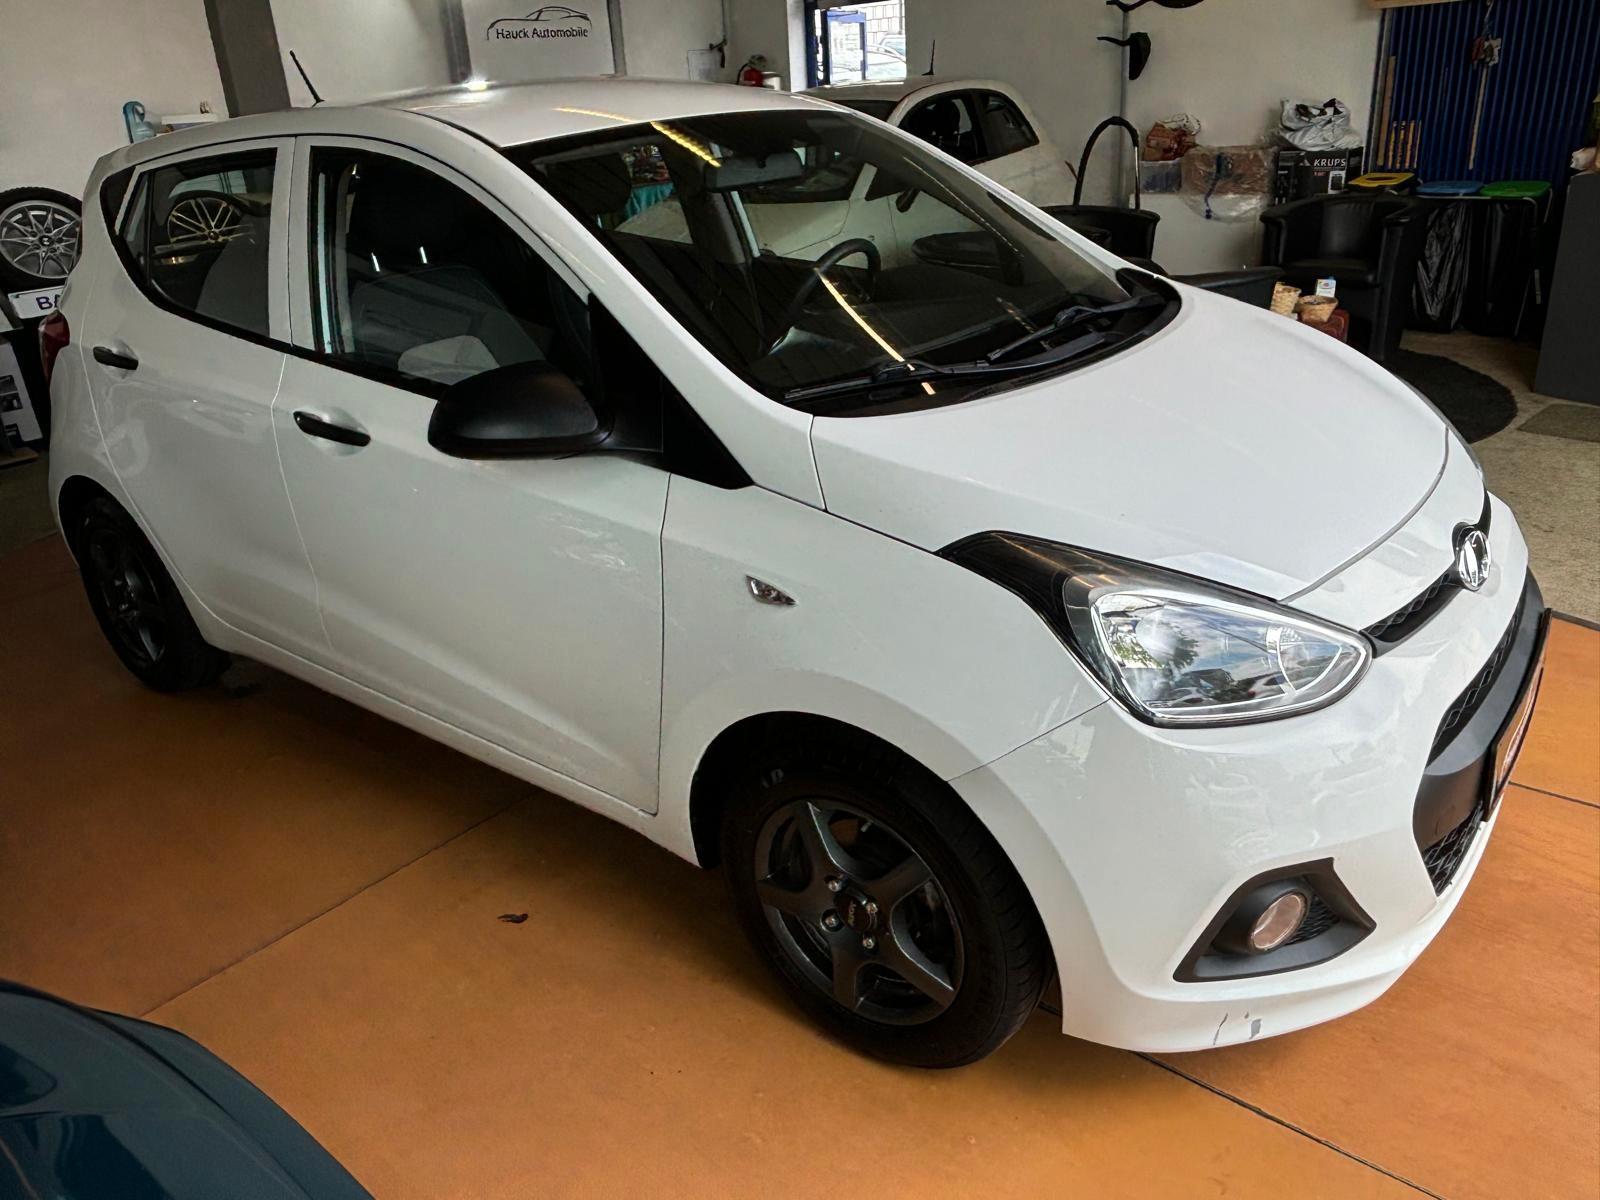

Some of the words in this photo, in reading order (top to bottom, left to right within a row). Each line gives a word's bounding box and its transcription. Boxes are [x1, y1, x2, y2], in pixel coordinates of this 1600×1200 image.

[496, 28, 530, 39] Hauck
[531, 27, 588, 38] Automobile
[1313, 158, 1347, 167] KRUPS
